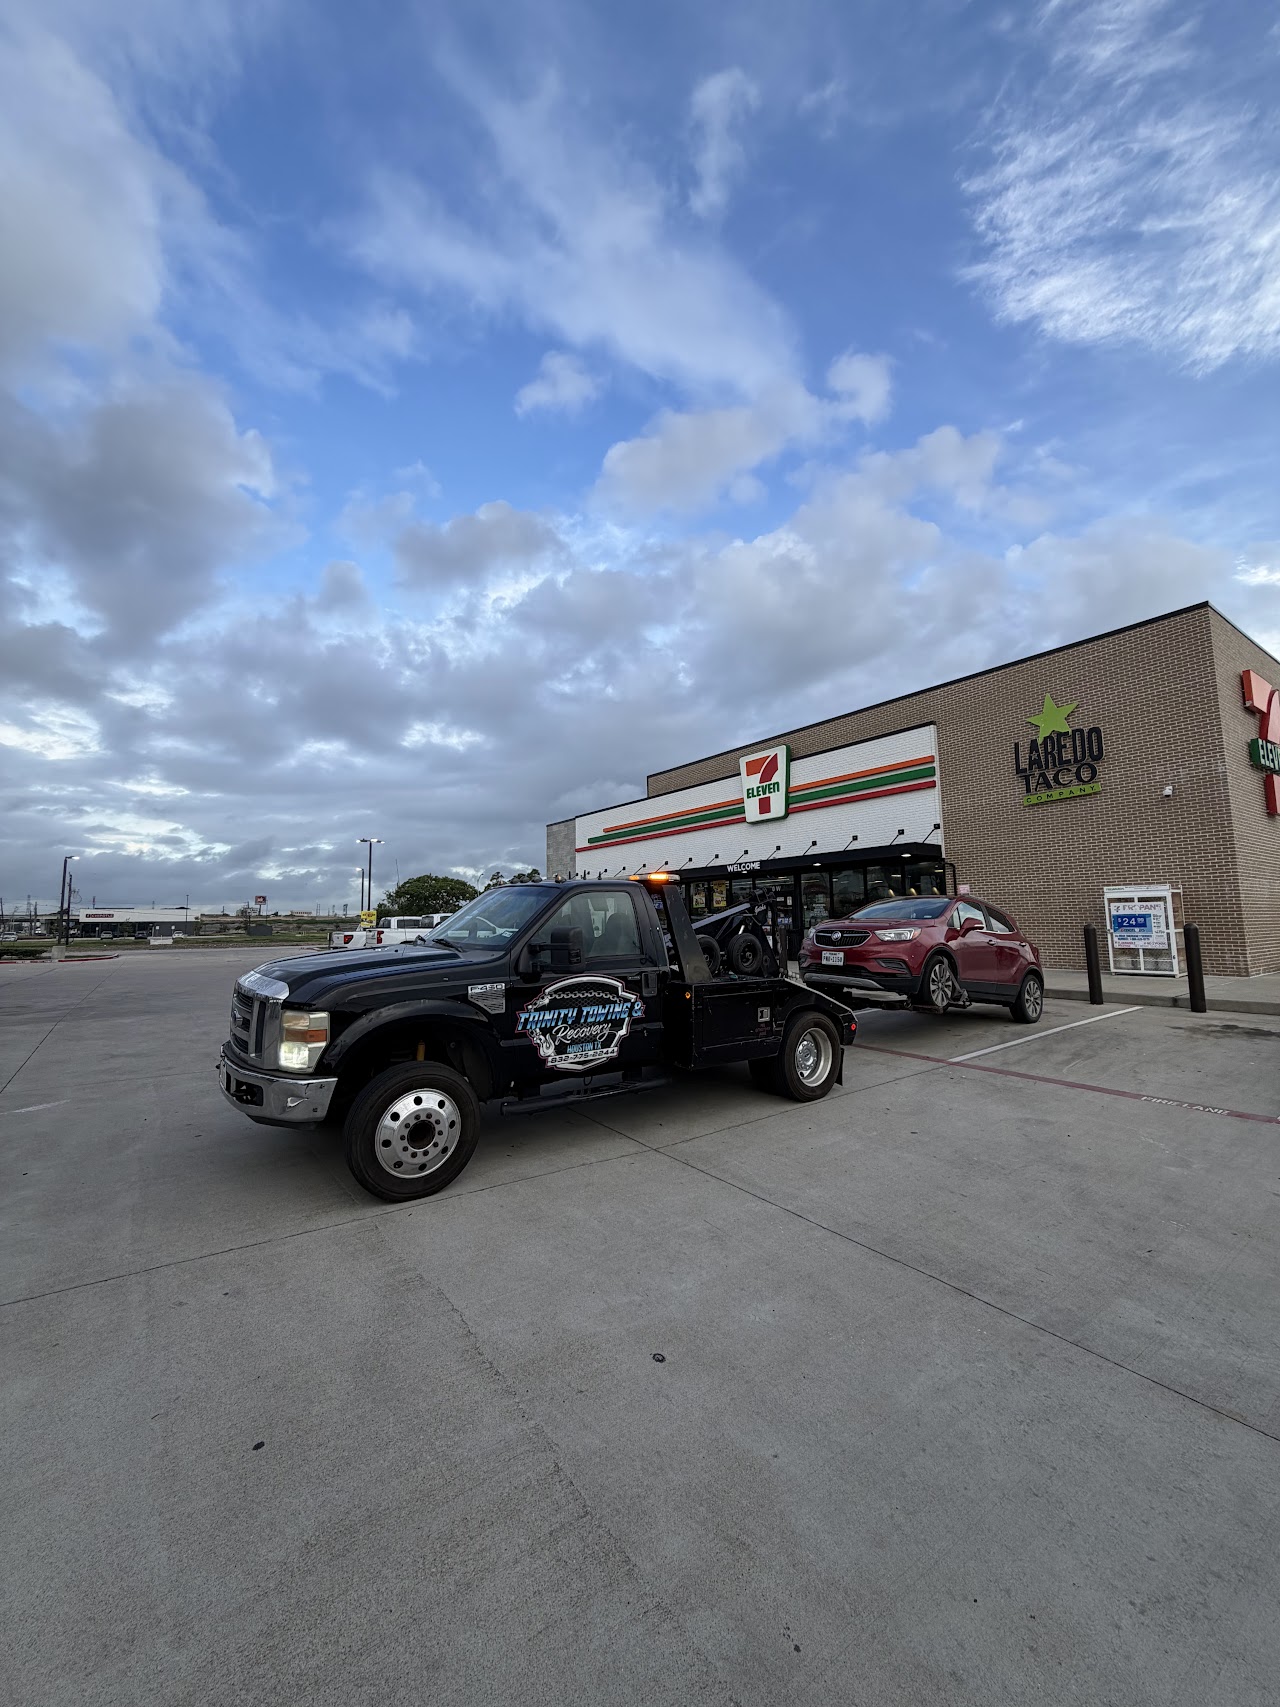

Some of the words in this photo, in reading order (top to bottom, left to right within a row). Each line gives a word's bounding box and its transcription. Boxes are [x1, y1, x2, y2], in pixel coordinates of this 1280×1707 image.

[1014, 727, 1104, 775] LAREDO
[745, 753, 779, 815] 7
[1018, 762, 1098, 794] TACO
[1026, 785, 1096, 803] COMPANY
[726, 861, 761, 873] WELCOME
[517, 1008, 578, 1031] TRINITY
[580, 1002, 631, 1023] TOWING
[632, 1001, 644, 1017] &
[552, 1023, 614, 1045] Recovery
[550, 1048, 616, 1064] 832-775-2244
[566, 1042, 594, 1053] HOUSTON
[594, 1041, 602, 1050] TX
[1140, 1096, 1179, 1107] FIRE
[1182, 1103, 1231, 1116] LANE
